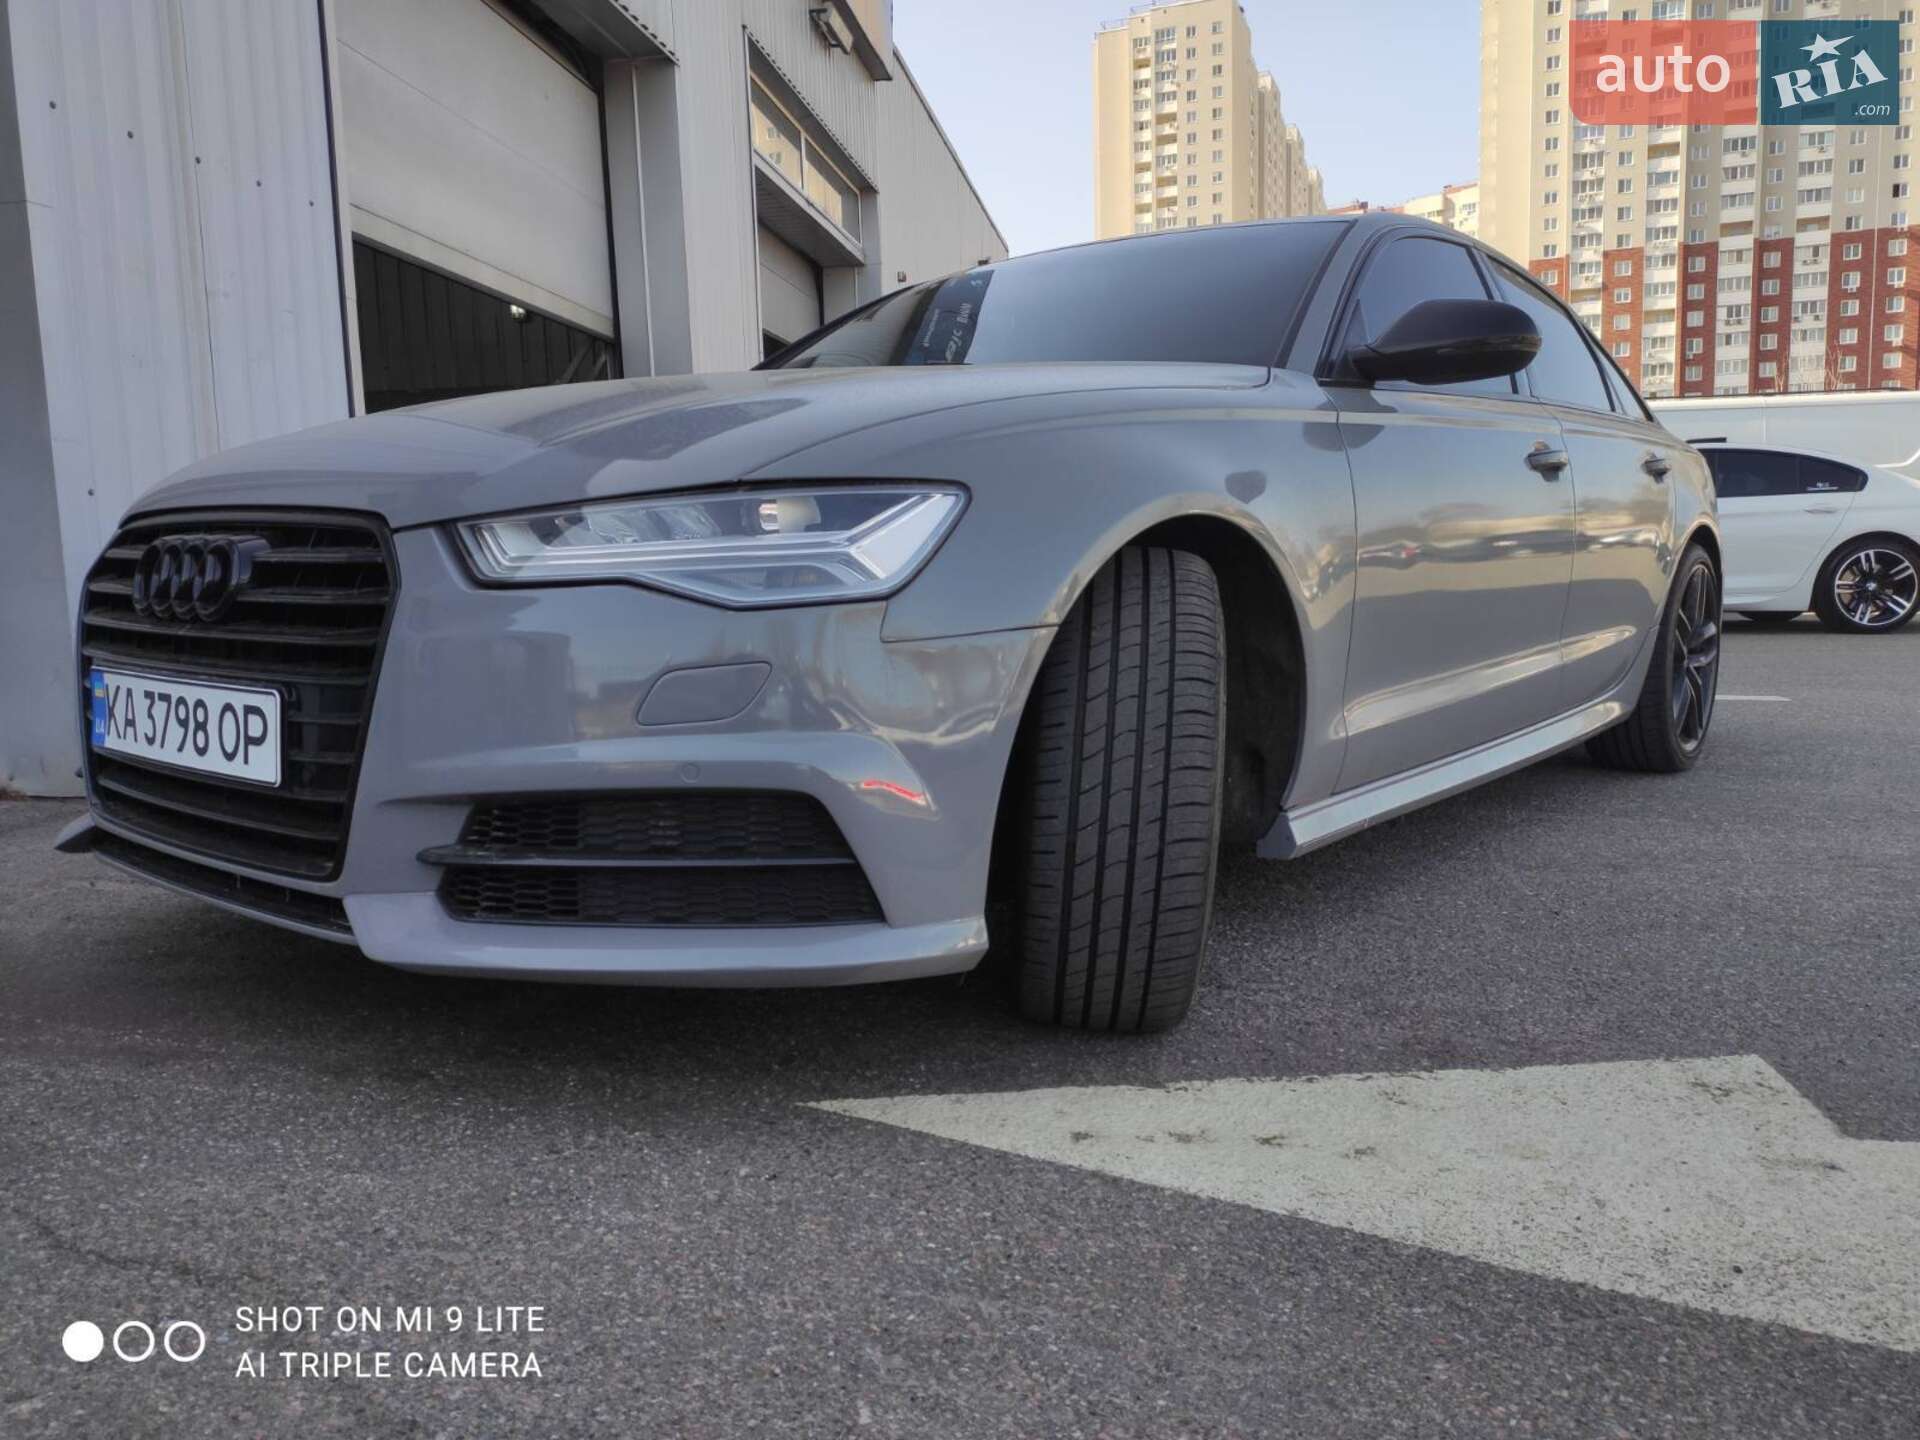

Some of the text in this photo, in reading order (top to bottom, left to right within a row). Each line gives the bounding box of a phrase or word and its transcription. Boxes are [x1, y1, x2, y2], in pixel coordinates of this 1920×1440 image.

[105, 684, 269, 765] KA 3798 OP
